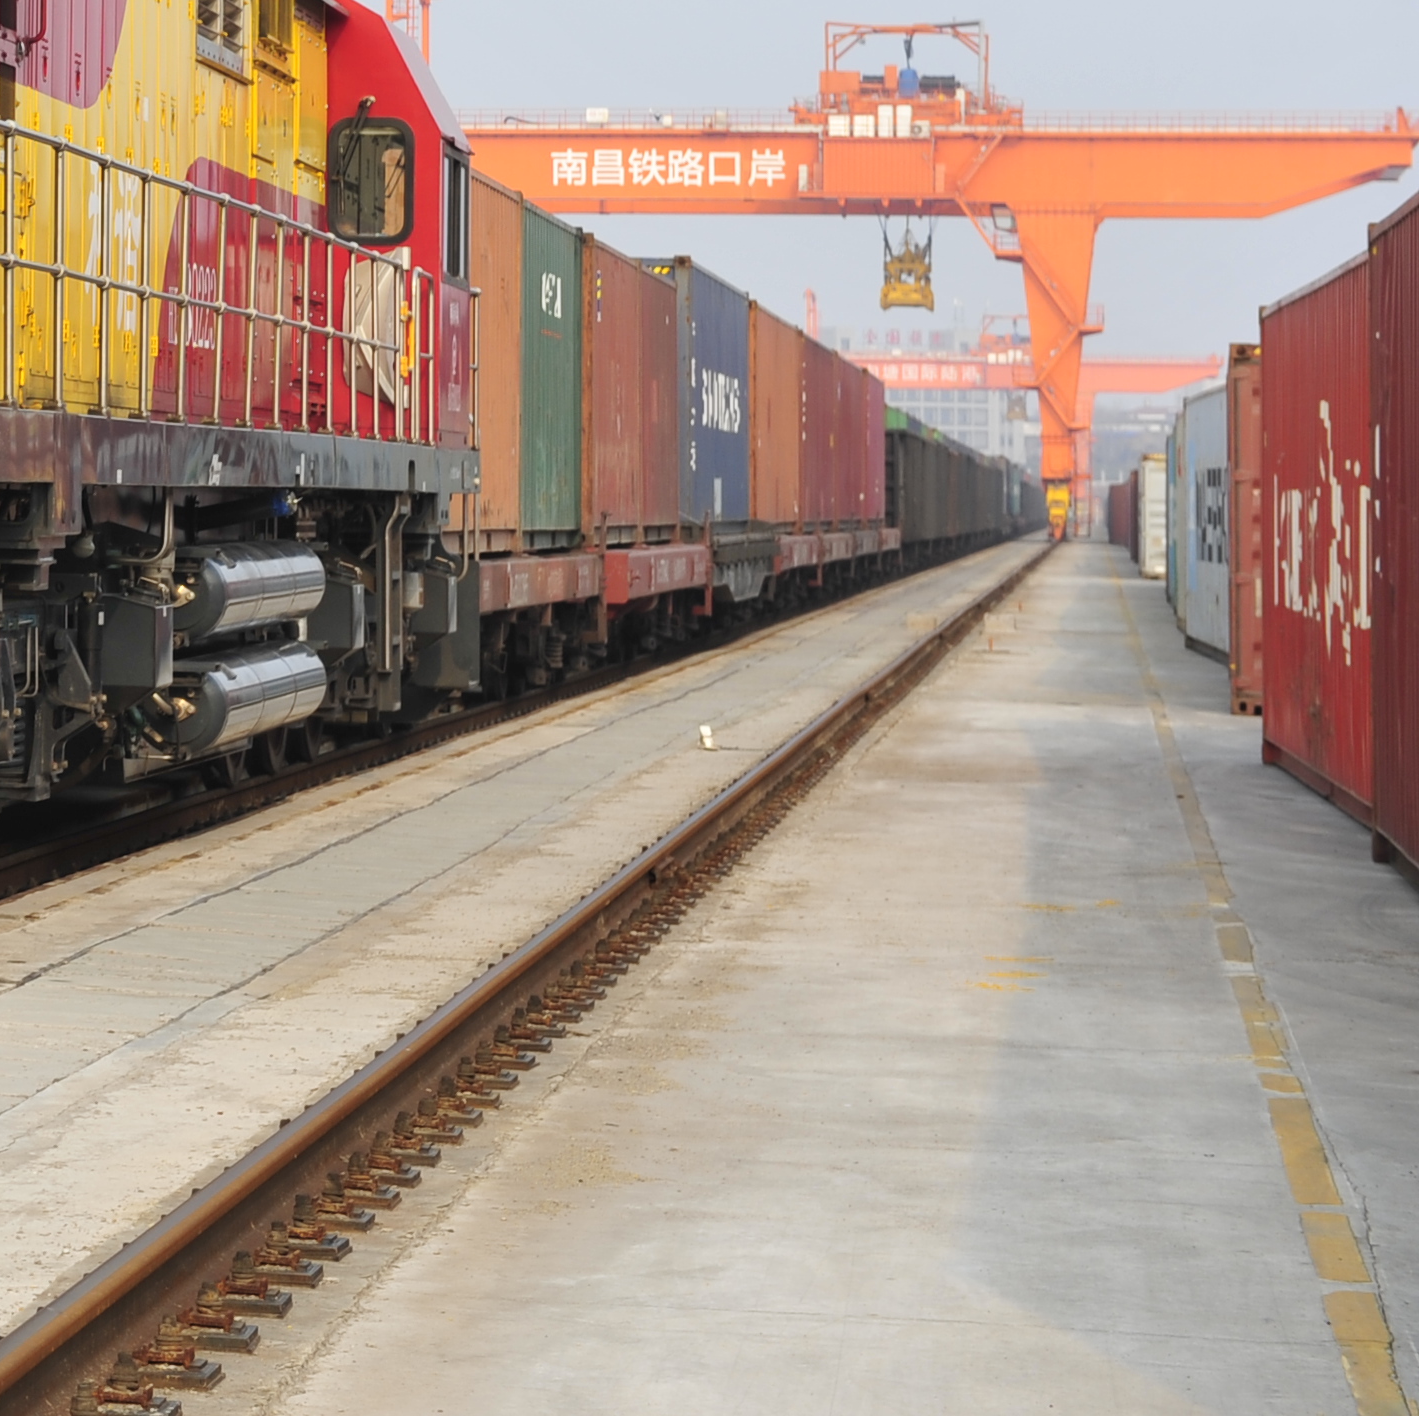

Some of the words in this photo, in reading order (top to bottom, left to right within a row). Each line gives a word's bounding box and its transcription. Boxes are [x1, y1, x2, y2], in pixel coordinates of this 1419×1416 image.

[550, 147, 787, 188] 南昌铁路口岸
